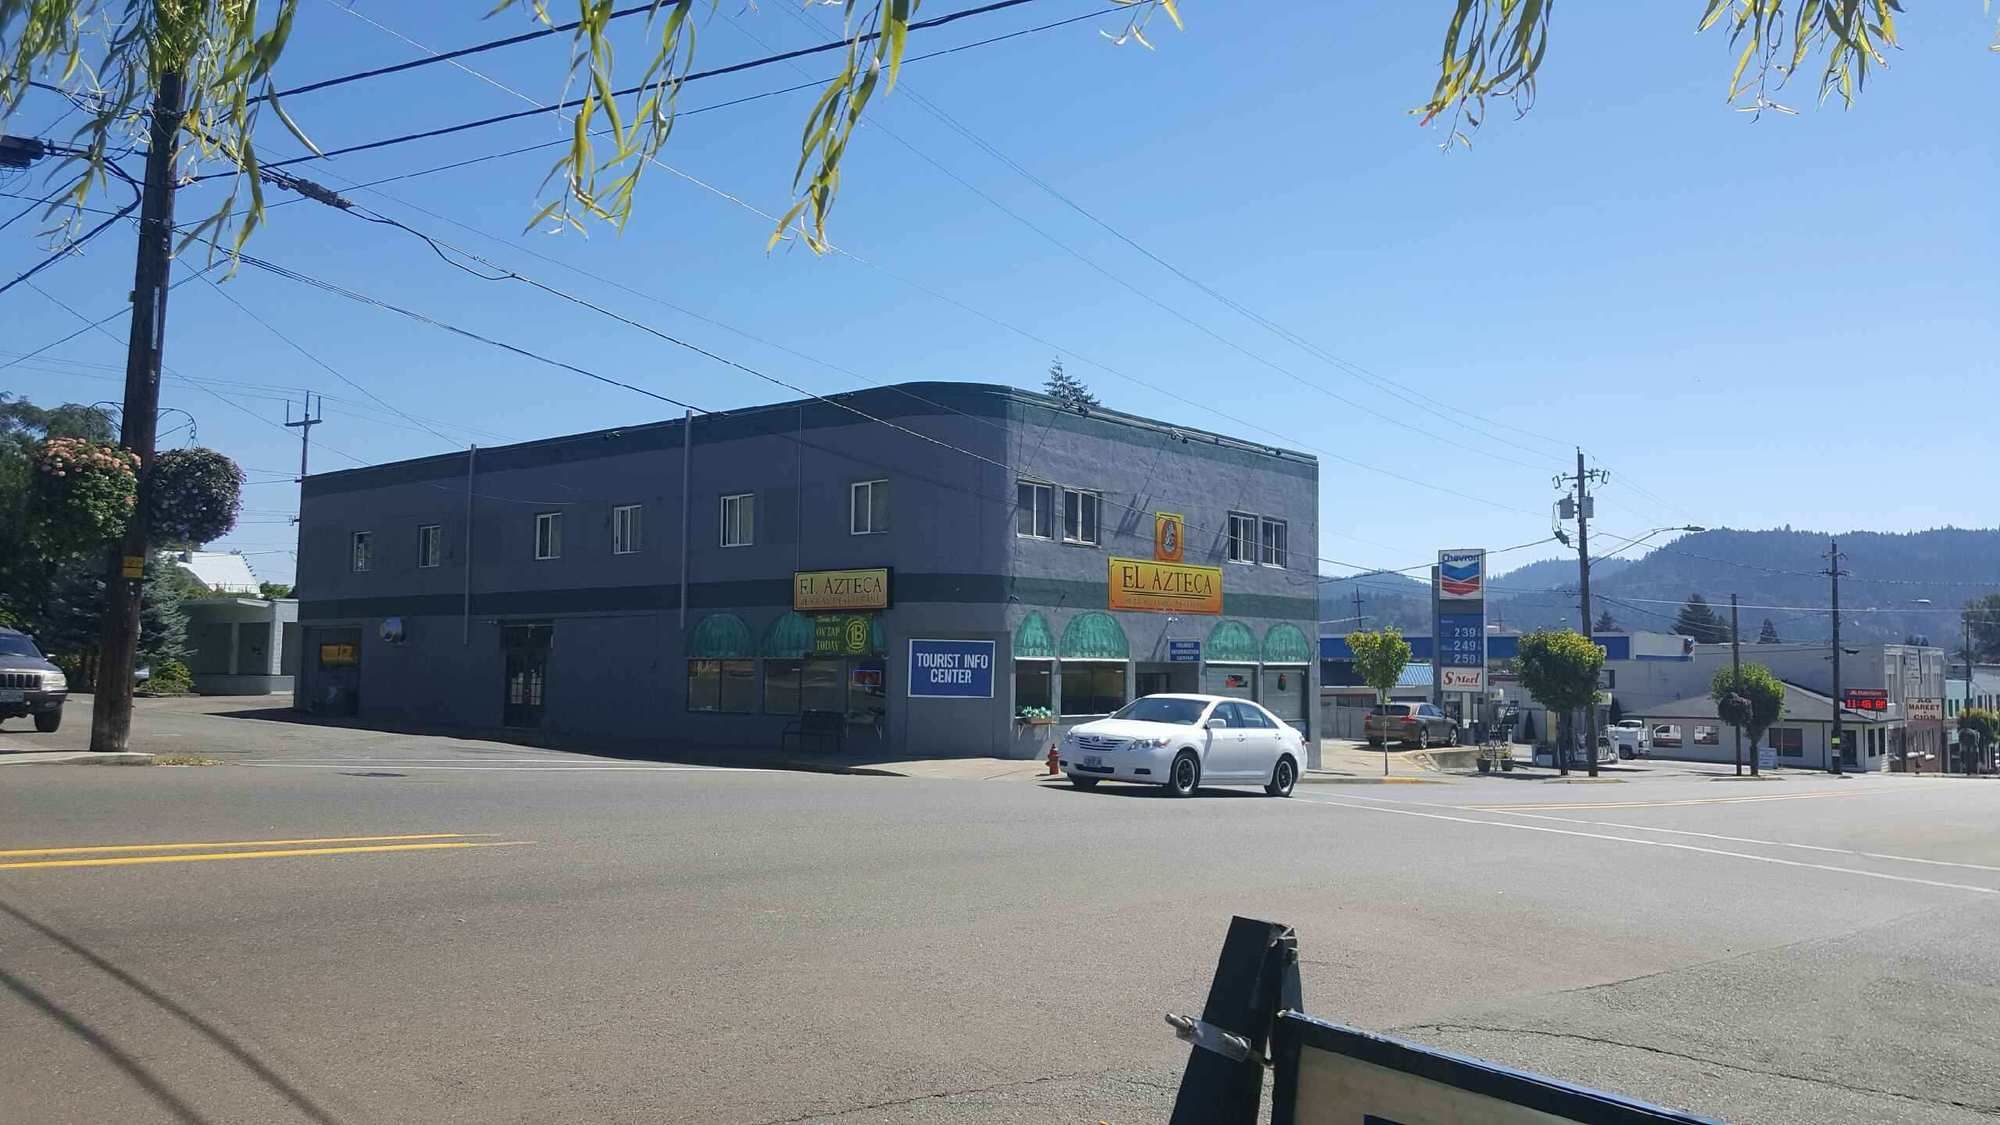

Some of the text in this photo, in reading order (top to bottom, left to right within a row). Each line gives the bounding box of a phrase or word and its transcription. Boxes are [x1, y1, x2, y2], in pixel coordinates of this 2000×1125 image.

[1442, 554, 1480, 562] Chevron
[800, 577, 882, 595] EL AZTECA
[1122, 565, 1212, 594] EL AZTECA
[1454, 640, 1476, 651] 249
[916, 653, 988, 669] TOURIST INFO
[930, 668, 971, 684] CENTER
